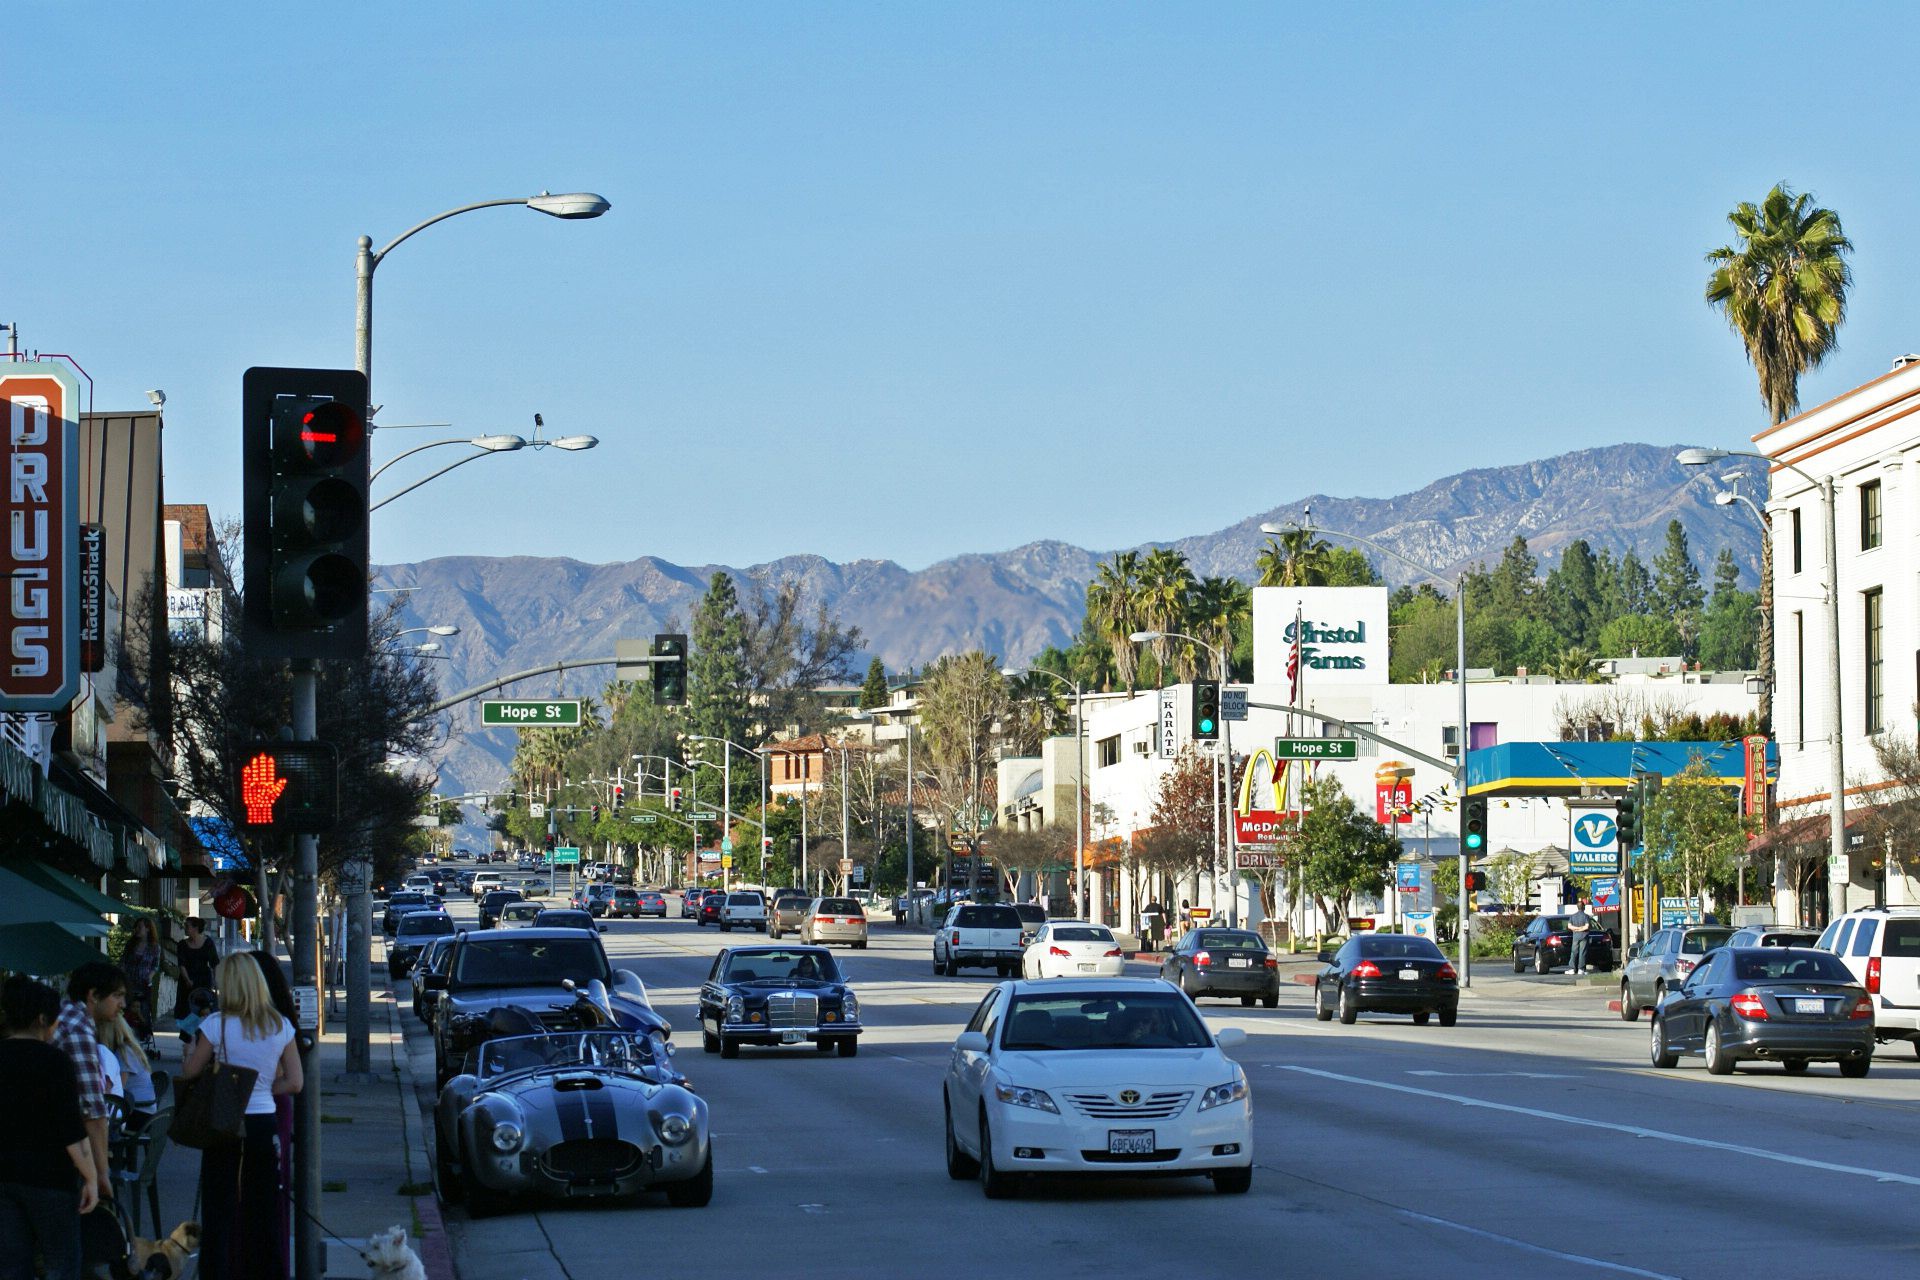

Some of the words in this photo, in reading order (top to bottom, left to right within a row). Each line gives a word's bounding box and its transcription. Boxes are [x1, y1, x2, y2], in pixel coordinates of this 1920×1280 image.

[10, 395, 49, 677] DRUGS
[81, 529, 100, 642] RadioShack
[1283, 620, 1367, 644] Bristol
[1223, 691, 1232, 699] DO
[1233, 691, 1247, 699] NOT
[501, 705, 538, 721] Hope
[545, 705, 561, 718] St
[1223, 702, 1246, 710] BLOCK
[1164, 701, 1175, 756] KARATE
[1292, 742, 1323, 756] Hope
[1328, 742, 1343, 753] St
[1574, 853, 1617, 863] VALERO
